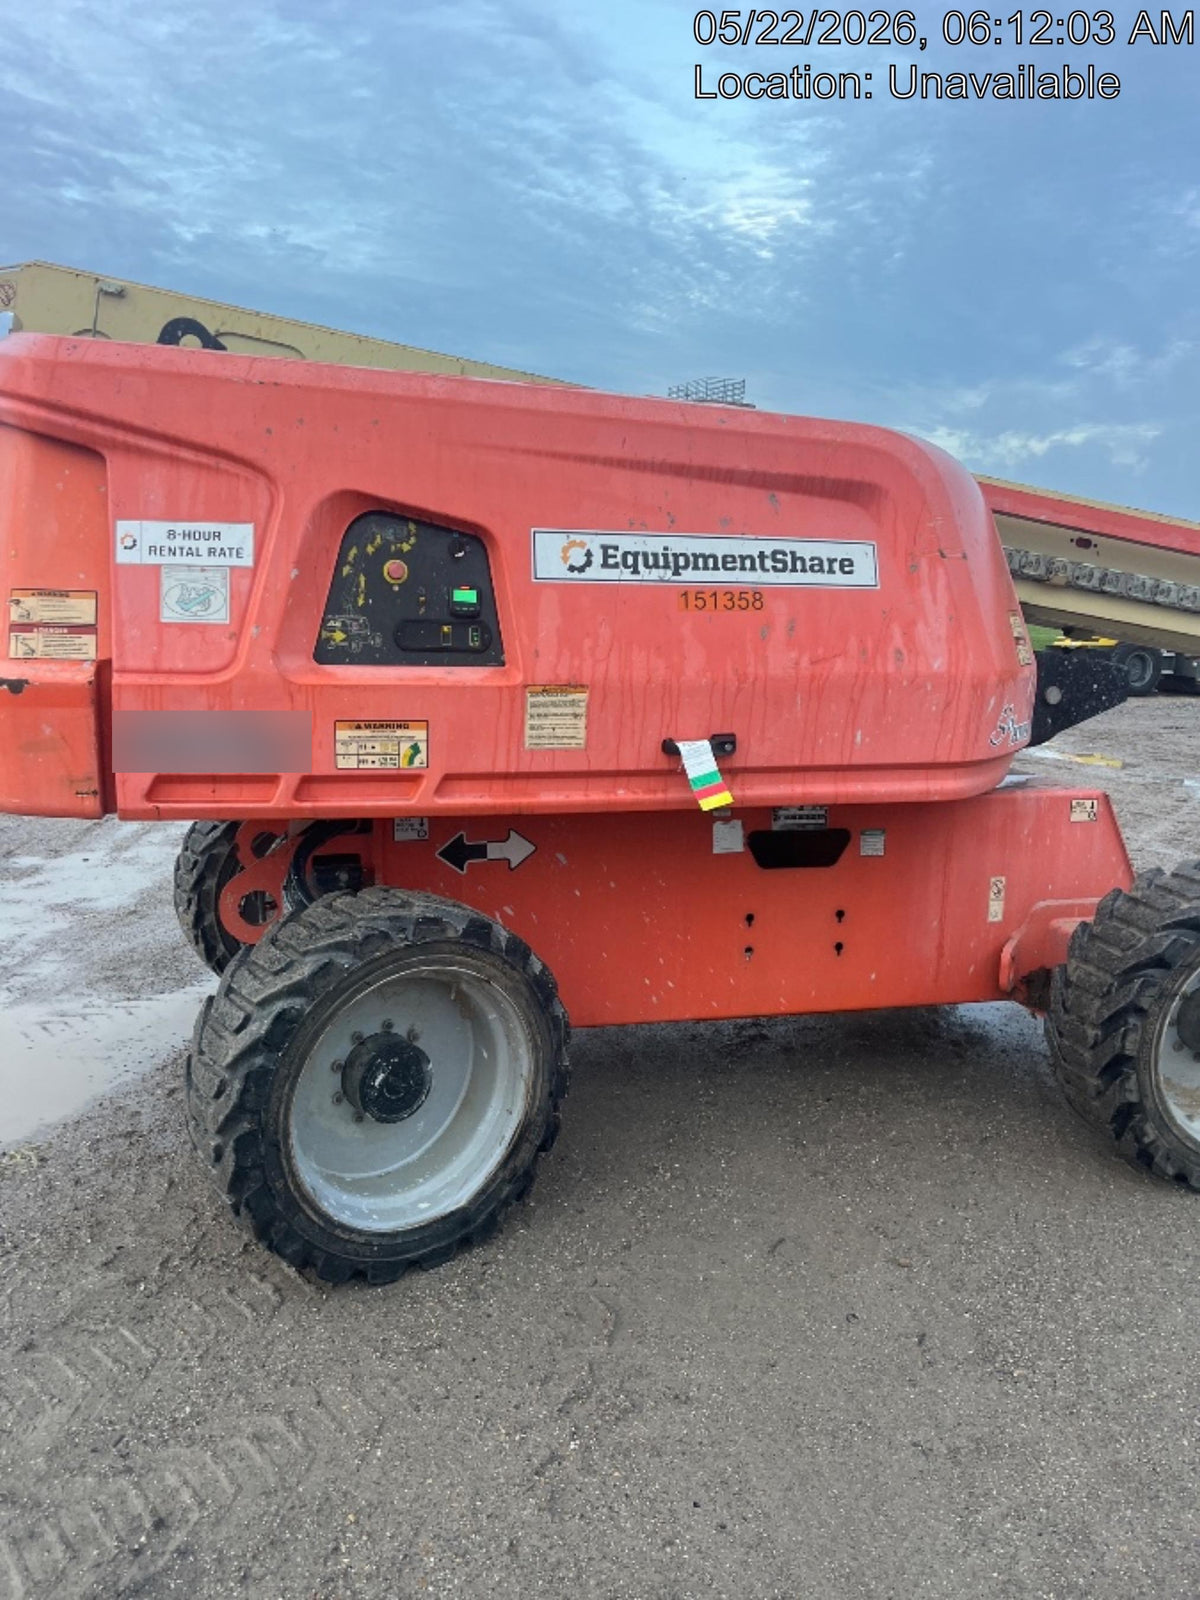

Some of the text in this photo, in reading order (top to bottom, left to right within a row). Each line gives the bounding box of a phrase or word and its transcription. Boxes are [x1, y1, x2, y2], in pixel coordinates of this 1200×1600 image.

[166, 529, 222, 541] 8-HOUR
[148, 545, 244, 559] RENTAL RATE
[600, 544, 855, 576] EquipmentShare
[680, 591, 764, 611] 151358
